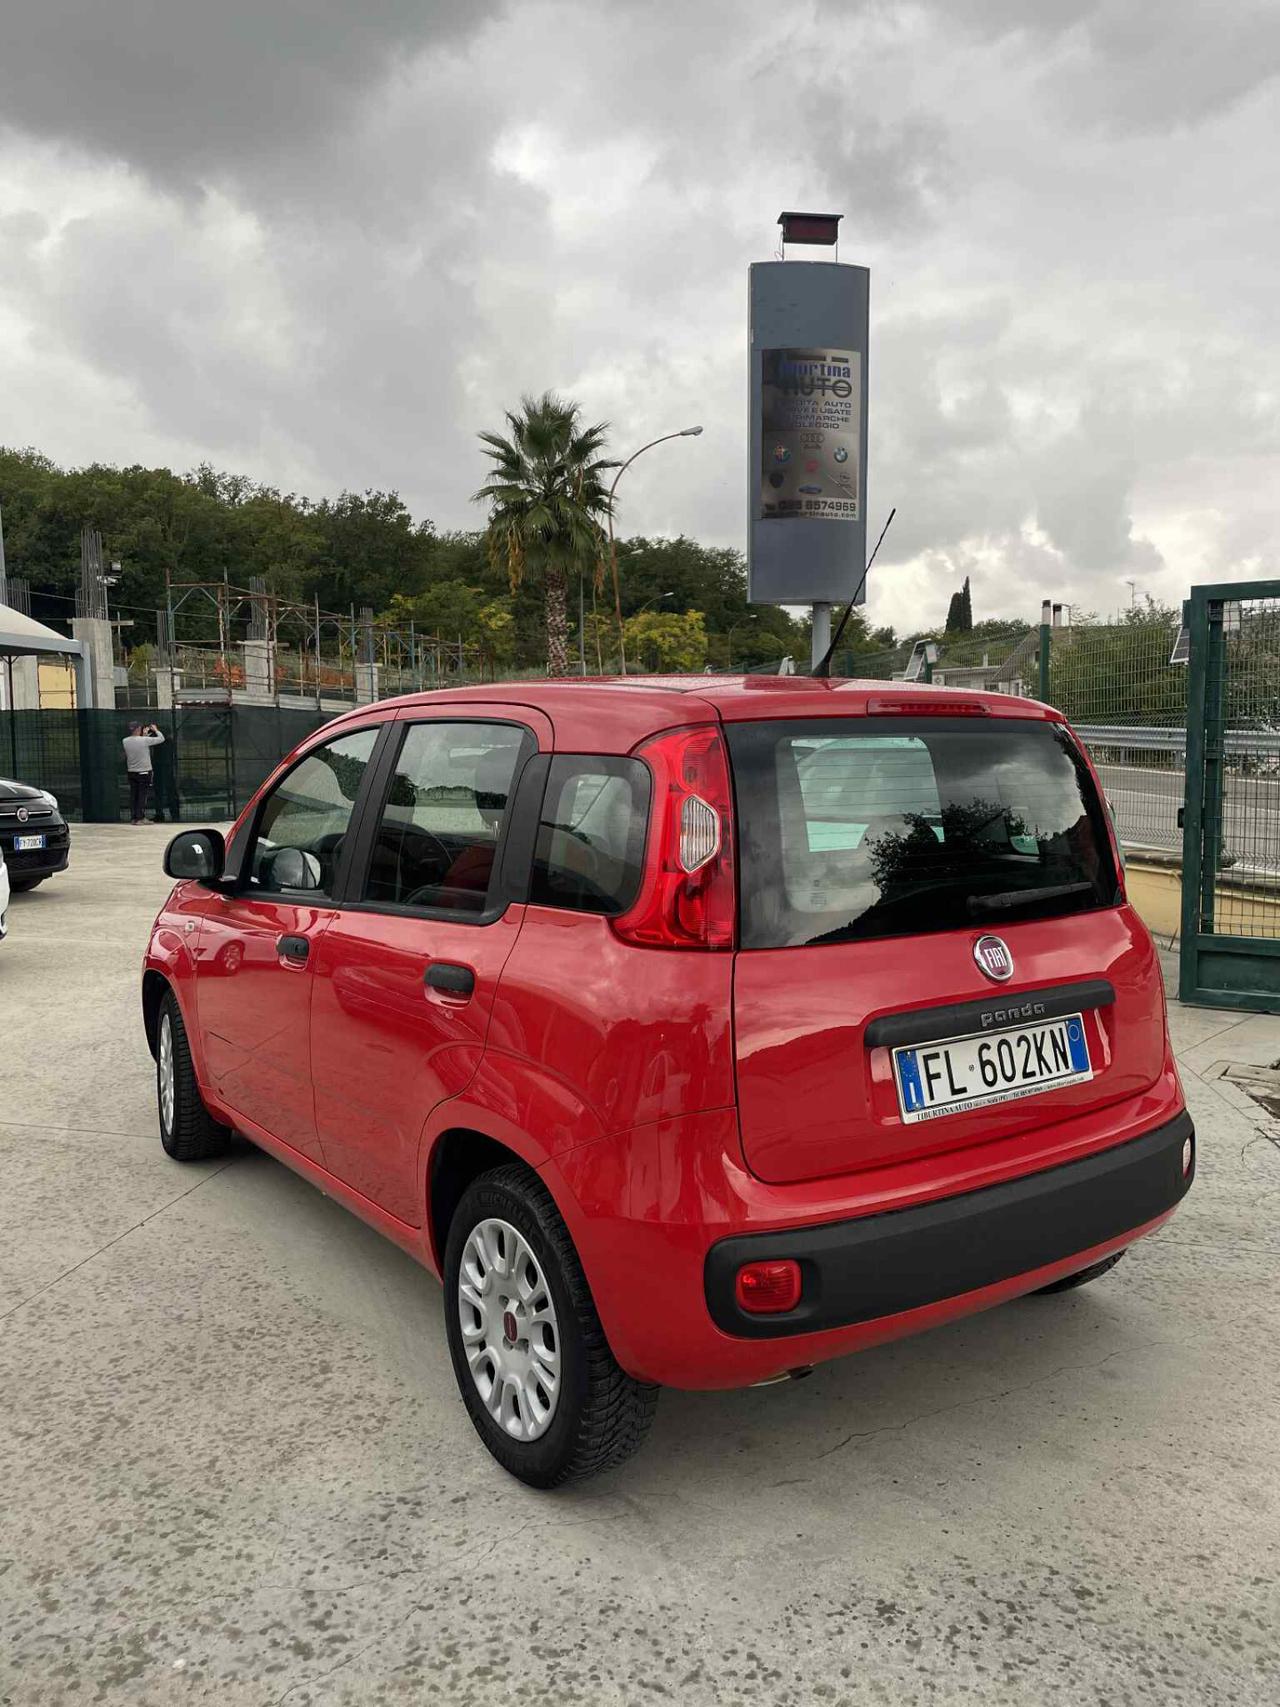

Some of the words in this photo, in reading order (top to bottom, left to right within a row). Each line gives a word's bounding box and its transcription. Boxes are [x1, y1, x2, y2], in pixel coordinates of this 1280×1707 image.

[819, 408, 852, 416] USATE
[824, 400, 852, 409] AUTO
[788, 421, 839, 430] OLEGGIO
[984, 946, 1007, 969] FIAT
[980, 1003, 1045, 1026] panda
[922, 1050, 967, 1102] FL
[977, 1028, 1070, 1088] 602KN
